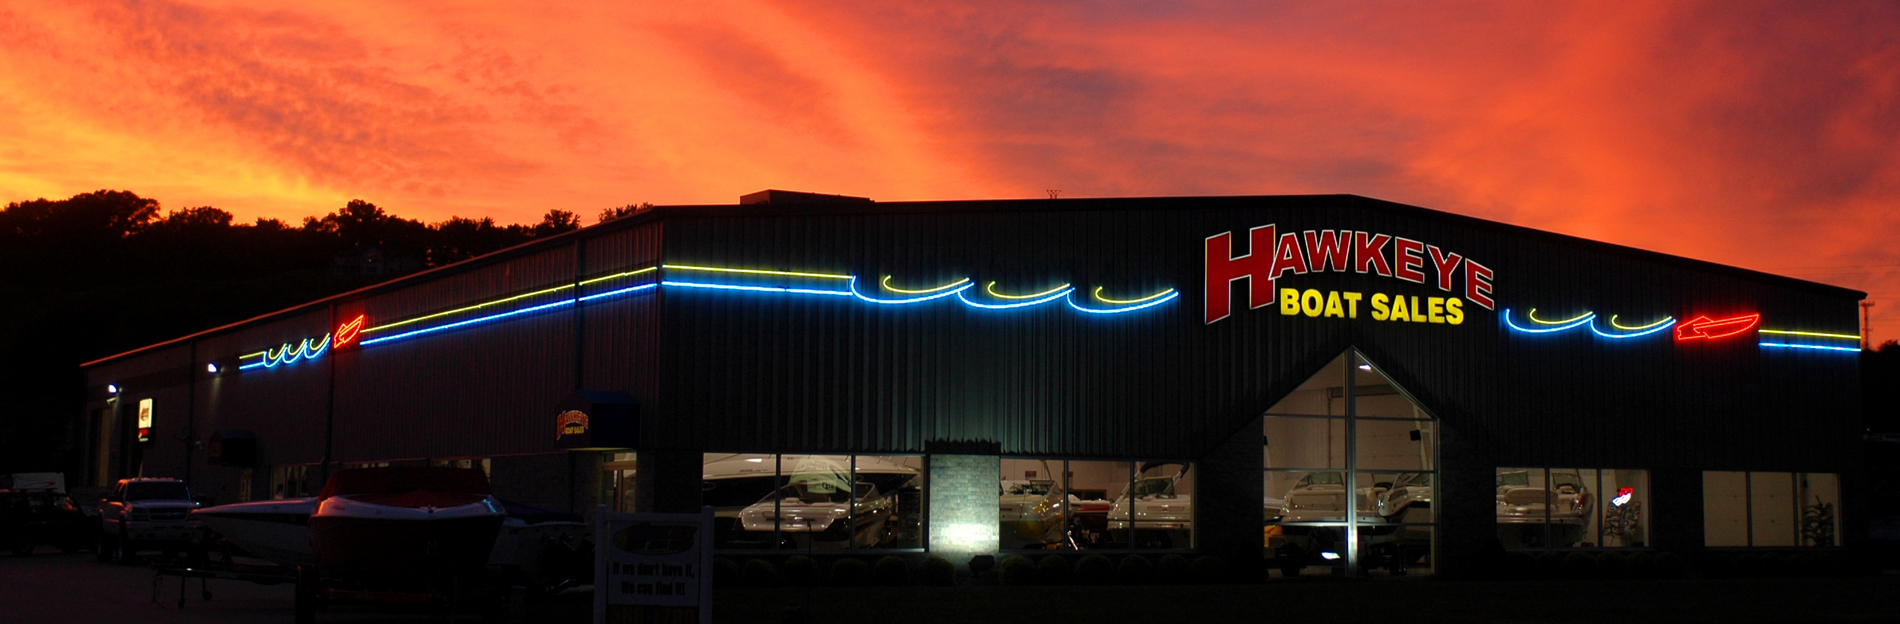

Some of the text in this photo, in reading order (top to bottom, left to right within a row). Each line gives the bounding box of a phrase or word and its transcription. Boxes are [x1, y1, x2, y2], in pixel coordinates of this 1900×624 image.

[1205, 223, 1494, 325] HAWKEYE
[1280, 288, 1465, 325] BOAT SALES
[613, 562, 620, 575] If
[623, 563, 635, 575] we
[638, 562, 659, 576] don't
[662, 563, 682, 576] have
[621, 581, 685, 596] We can find it!
